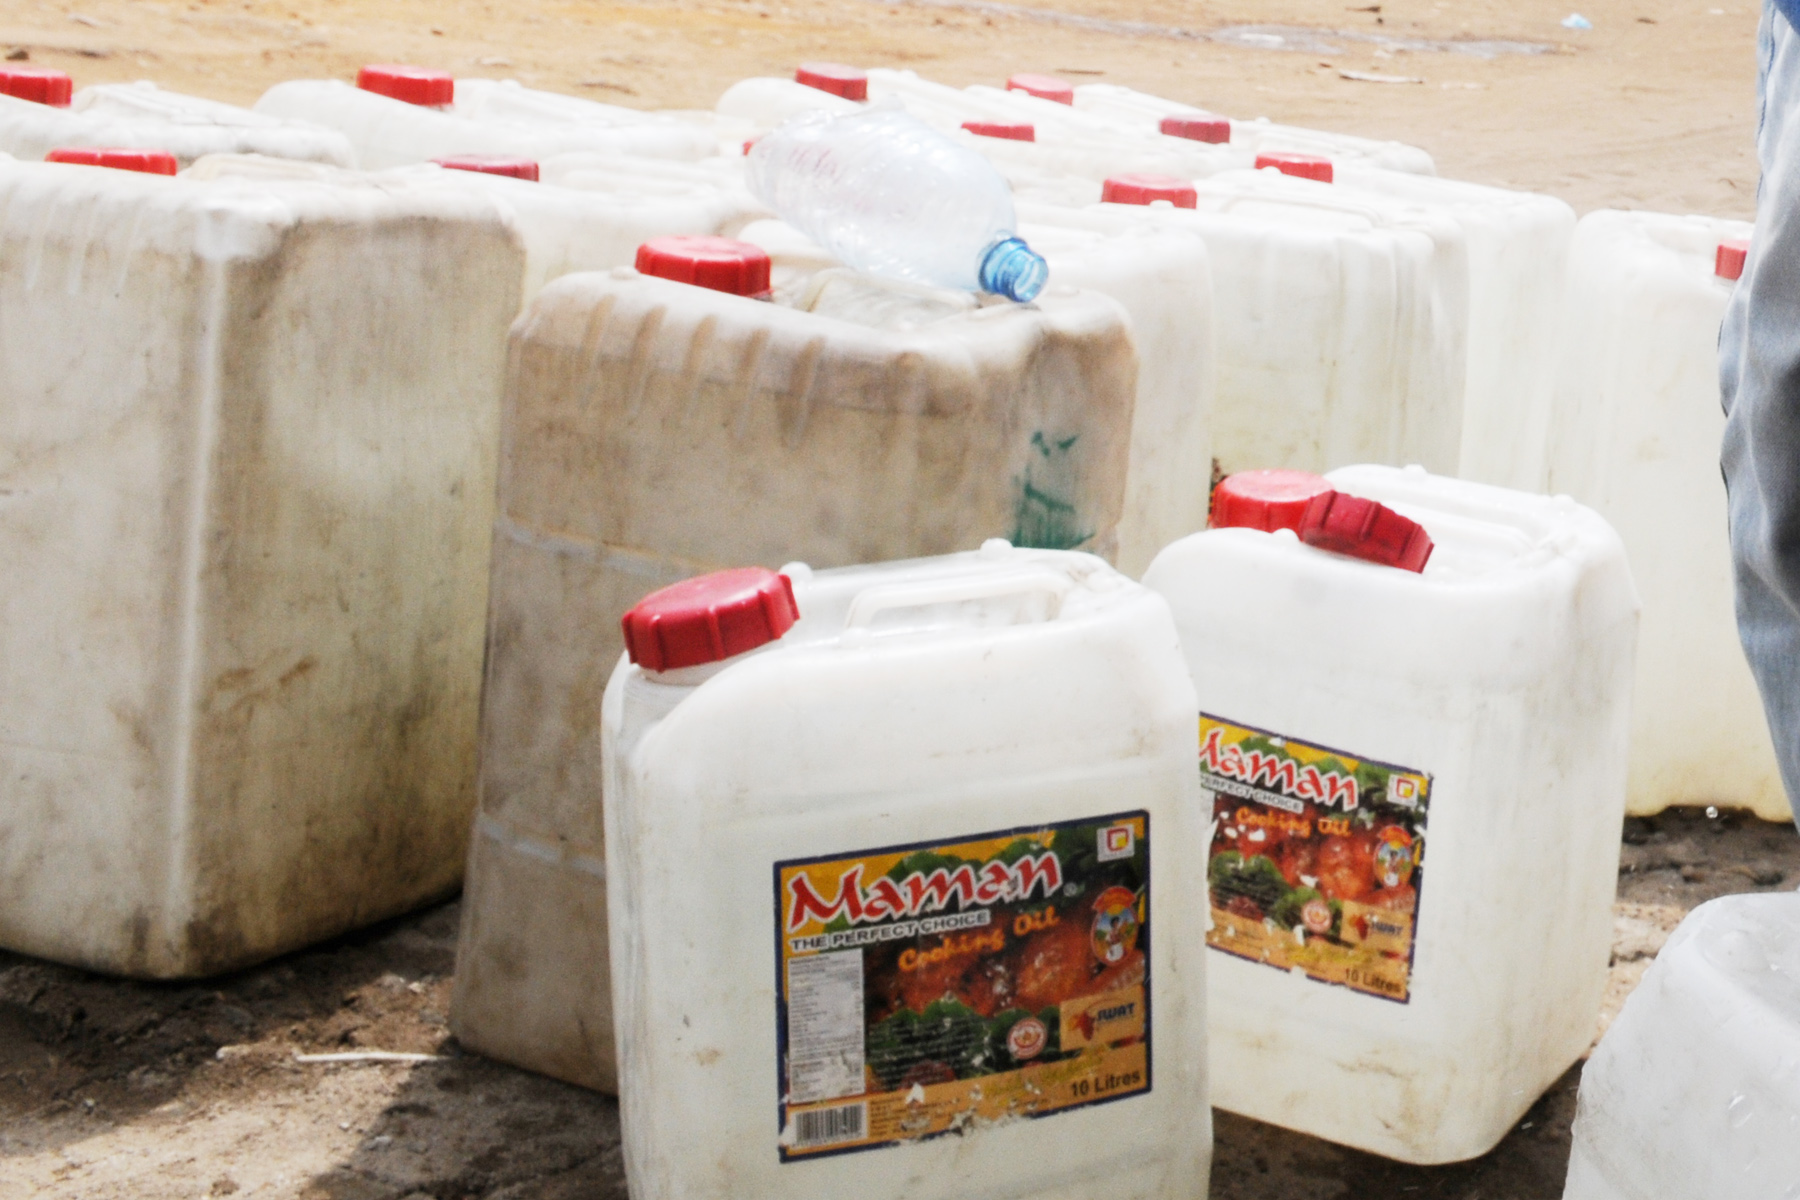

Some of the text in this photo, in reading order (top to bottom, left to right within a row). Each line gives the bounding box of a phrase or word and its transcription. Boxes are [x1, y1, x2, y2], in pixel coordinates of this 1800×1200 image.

[1201, 774, 1303, 812] ERFECT CHOICE
[1236, 806, 1311, 838] Cooking
[788, 852, 1062, 933] Maman
[791, 911, 989, 951] THE PERFECT CHOICE
[899, 906, 1061, 971] Cooking Oil
[1071, 1070, 1141, 1097] 10 Litres
